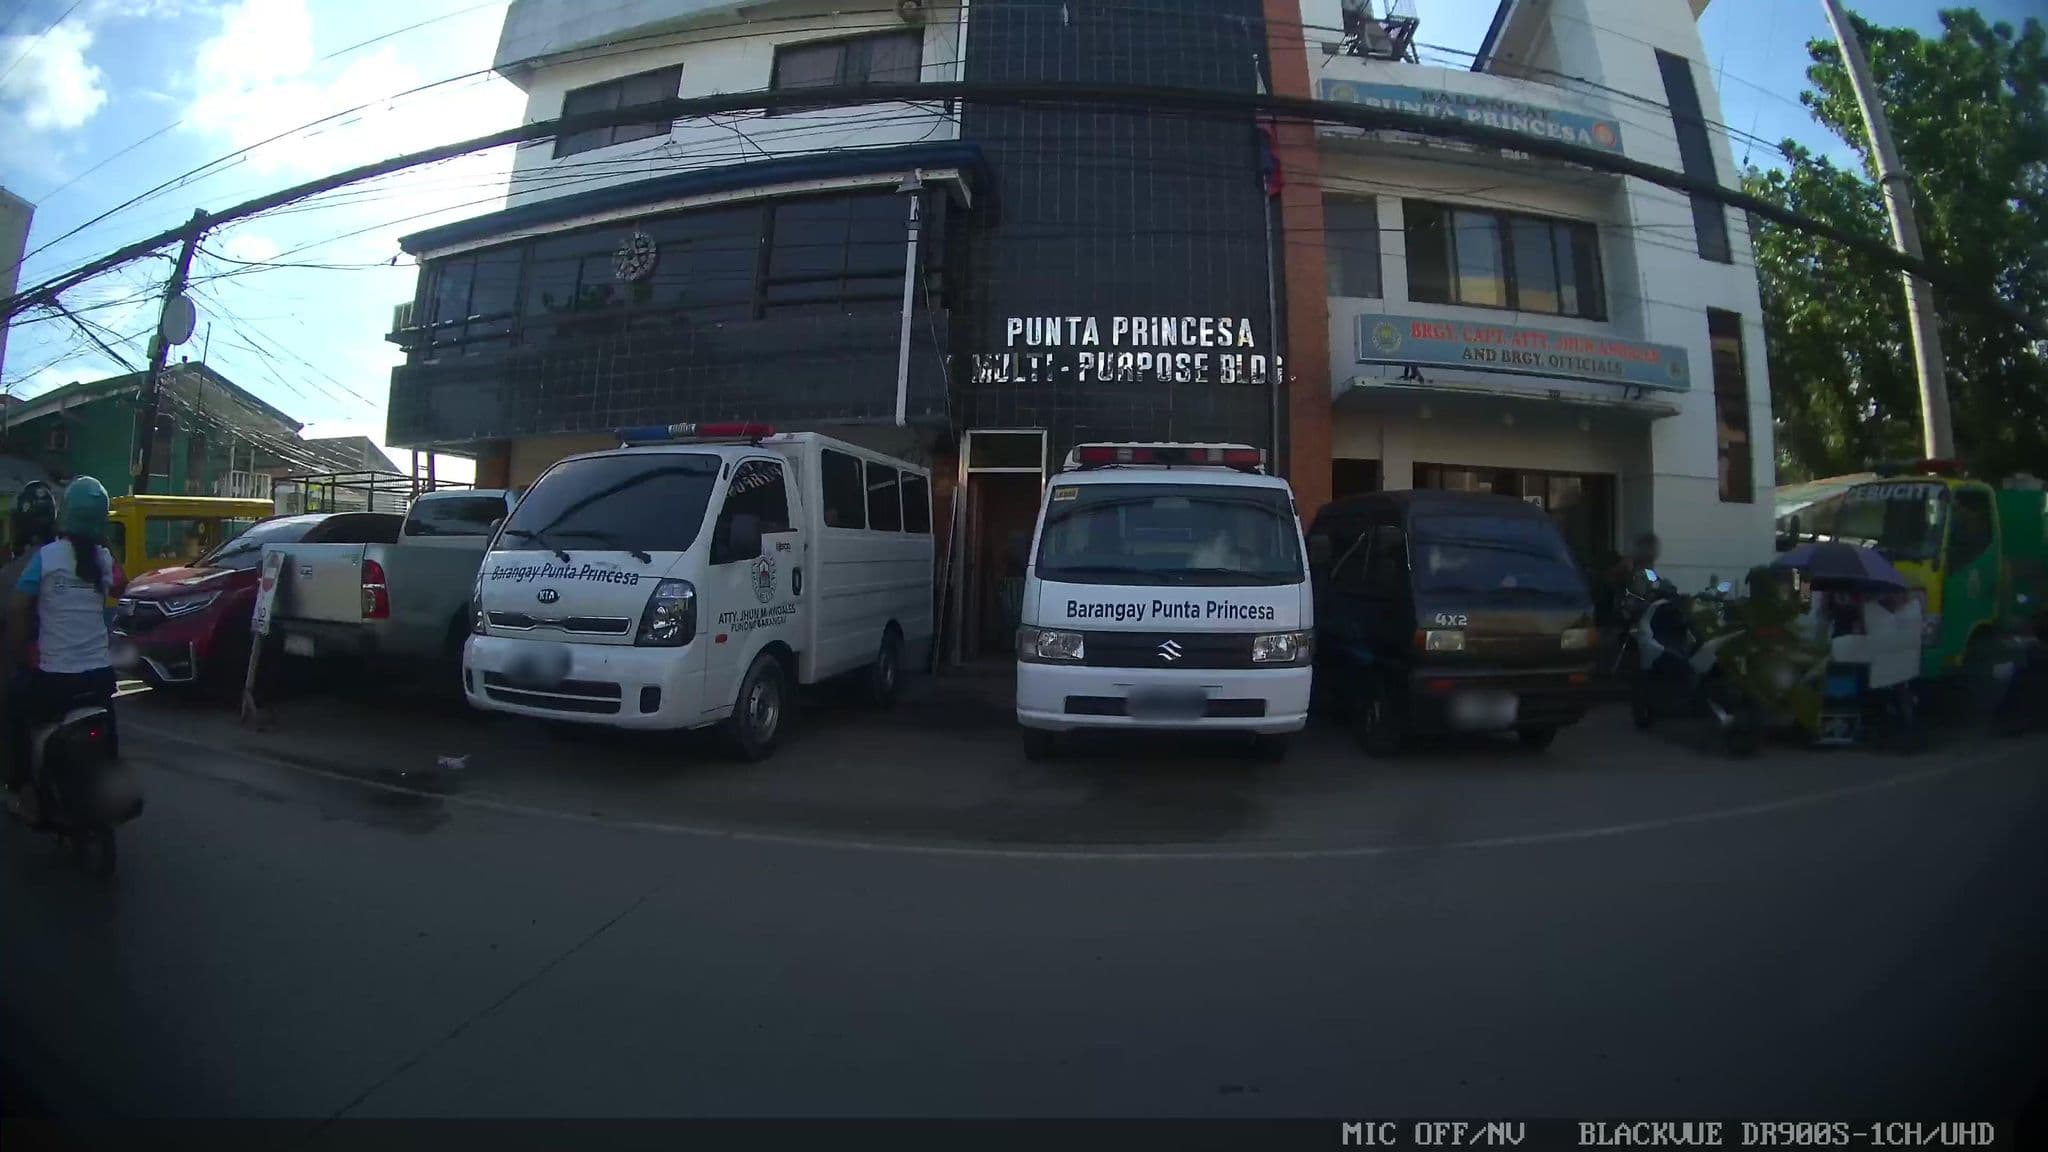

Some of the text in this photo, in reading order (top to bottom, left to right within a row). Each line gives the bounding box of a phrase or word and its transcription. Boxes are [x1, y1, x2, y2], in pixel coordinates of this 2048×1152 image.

[1466, 109, 1593, 146] PRINCESA
[1006, 316, 1255, 347] PUNTA PRINCESA
[1462, 346, 1496, 363] AND
[971, 352, 1054, 384] MULTI
[1078, 352, 1209, 384] PURPOSE
[491, 563, 640, 586] Barangay Punta Princesa
[539, 591, 556, 602] KIA
[1067, 600, 1275, 621] Barangay Punta Princesa
